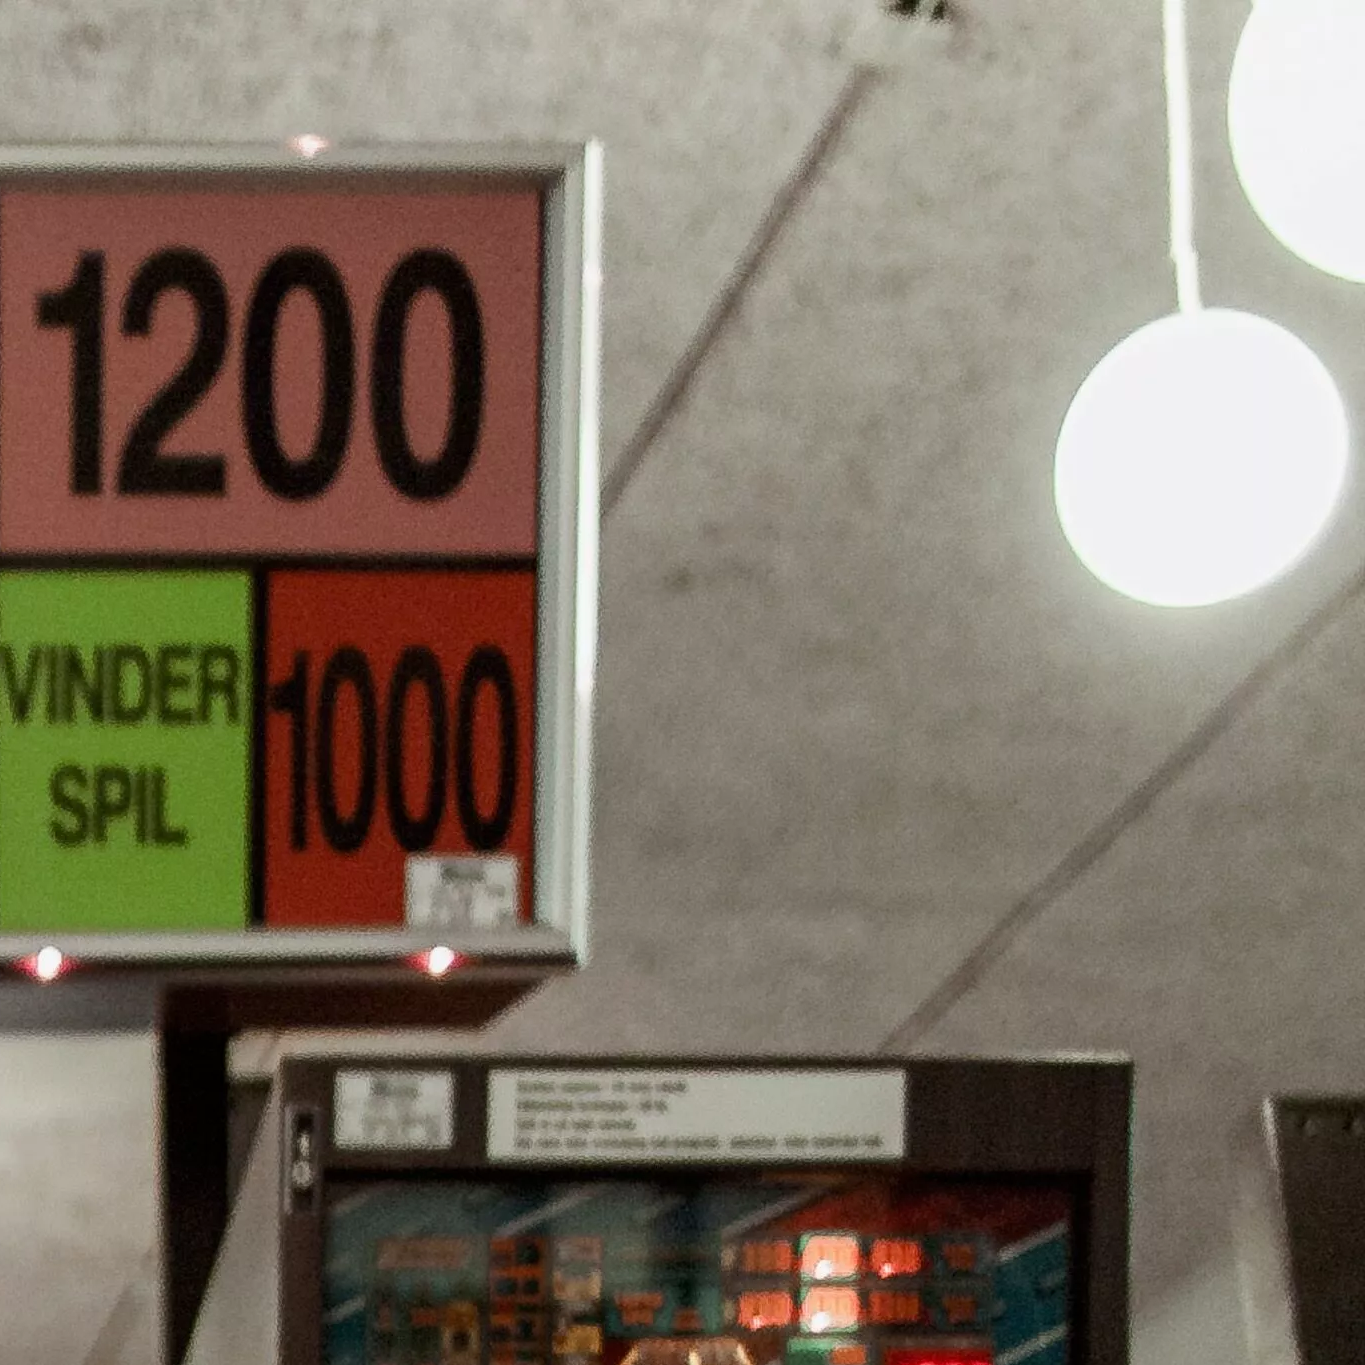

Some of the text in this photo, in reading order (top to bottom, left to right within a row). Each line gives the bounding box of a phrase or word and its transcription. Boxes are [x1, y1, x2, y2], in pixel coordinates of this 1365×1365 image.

[34, 245, 486, 502] 1200
[46, 764, 187, 849] SPIL
[269, 647, 519, 858] 1000
